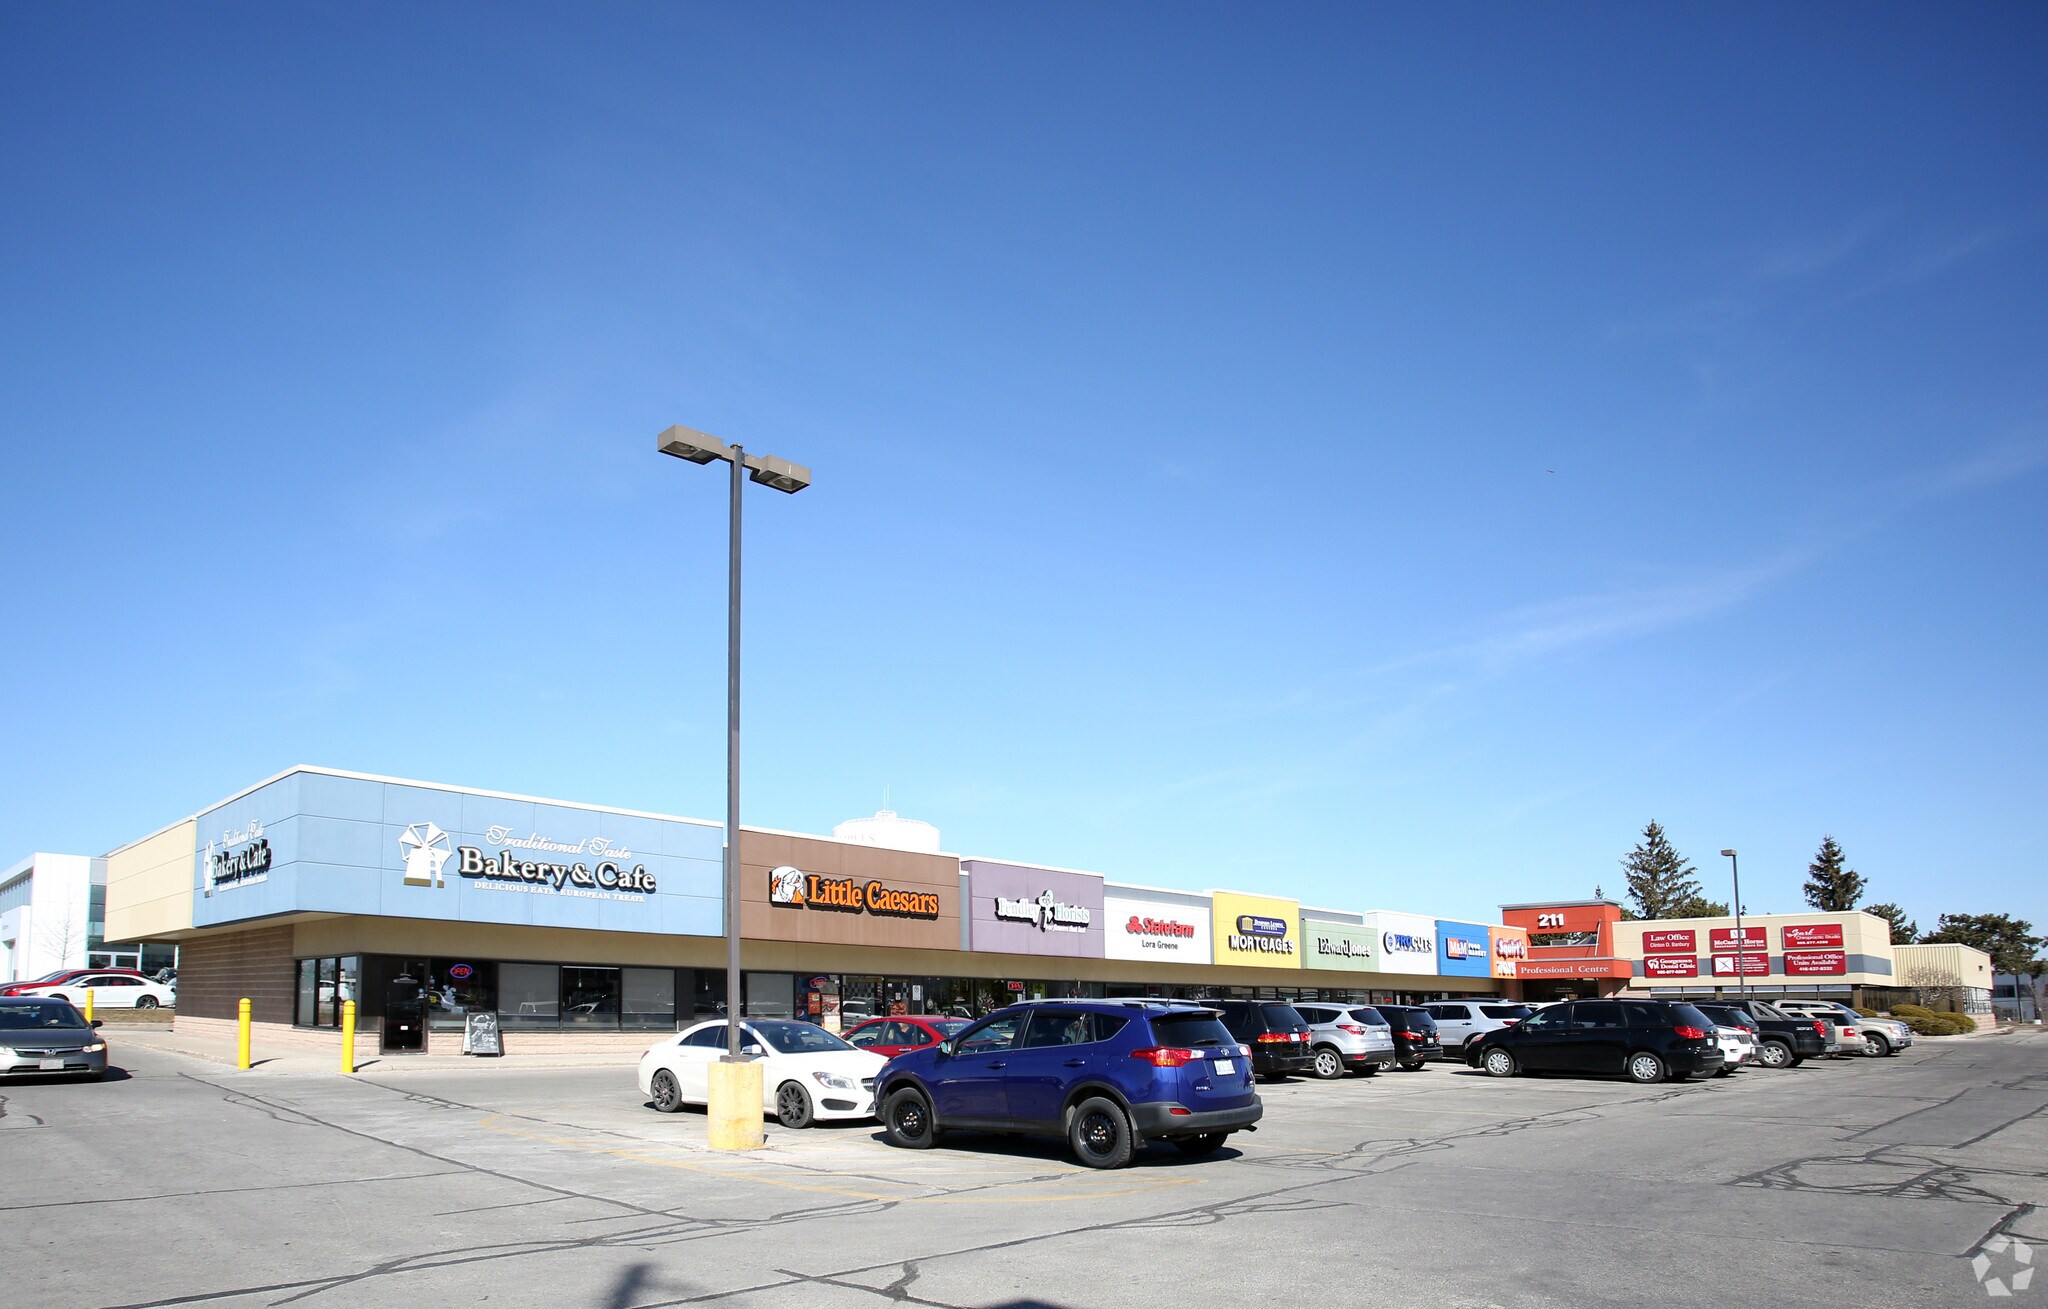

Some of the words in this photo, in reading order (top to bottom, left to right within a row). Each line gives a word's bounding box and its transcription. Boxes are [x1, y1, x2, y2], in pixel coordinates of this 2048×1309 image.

[486, 825, 586, 855] Traditional
[588, 836, 632, 860] Taste
[212, 852, 240, 879] Bakery
[247, 839, 267, 869] Cafe
[459, 846, 570, 889] Bakery
[571, 863, 595, 885] &
[597, 862, 656, 891] Cafe
[474, 881, 529, 894] DELICIOUS
[530, 886, 557, 896] EATS.
[560, 889, 611, 901] EUROPEAN
[612, 892, 646, 903] TREATS.
[808, 875, 864, 908] Little
[866, 882, 939, 914] Caesars
[1054, 902, 1090, 923] Florists
[1538, 913, 1564, 926] 211
[1142, 939, 1156, 949] Lora
[1157, 940, 1179, 950] Greene
[1231, 935, 1294, 953] MORTGAGES
[1319, 937, 1348, 955] Edward
[1347, 941, 1371, 957] Jones
[1521, 965, 1573, 974] Professional
[1578, 965, 1609, 973] Centre
